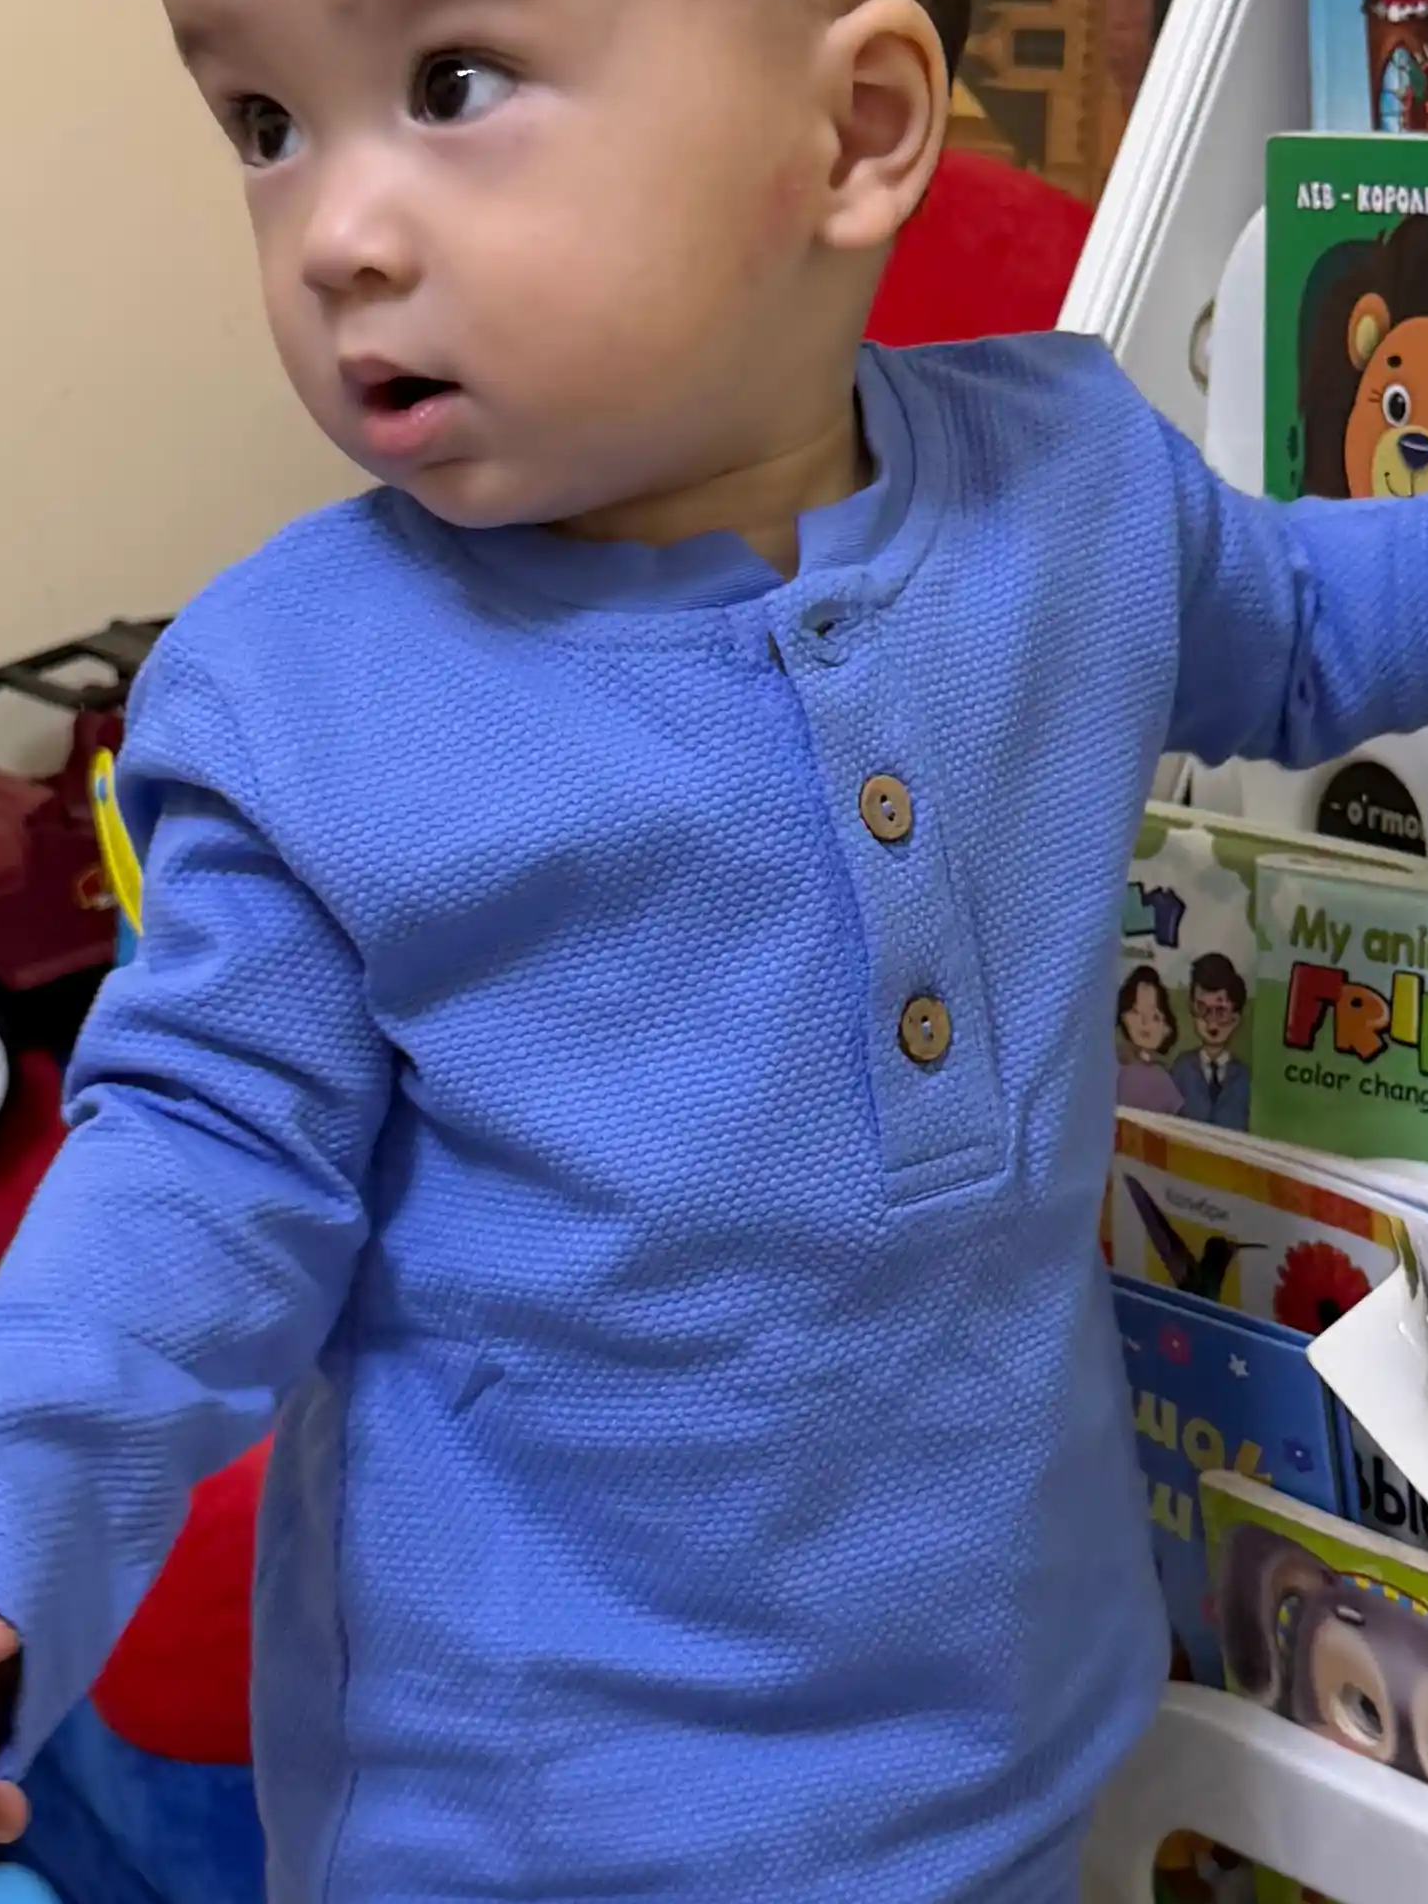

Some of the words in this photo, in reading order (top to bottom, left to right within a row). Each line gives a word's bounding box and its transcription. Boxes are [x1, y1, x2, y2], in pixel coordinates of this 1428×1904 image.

[1297, 181, 1335, 211] ЛЕВ
[1347, 793, 1425, 840] o'rmo
[1289, 904, 1353, 965] My
[1284, 1060, 1351, 1090] color
